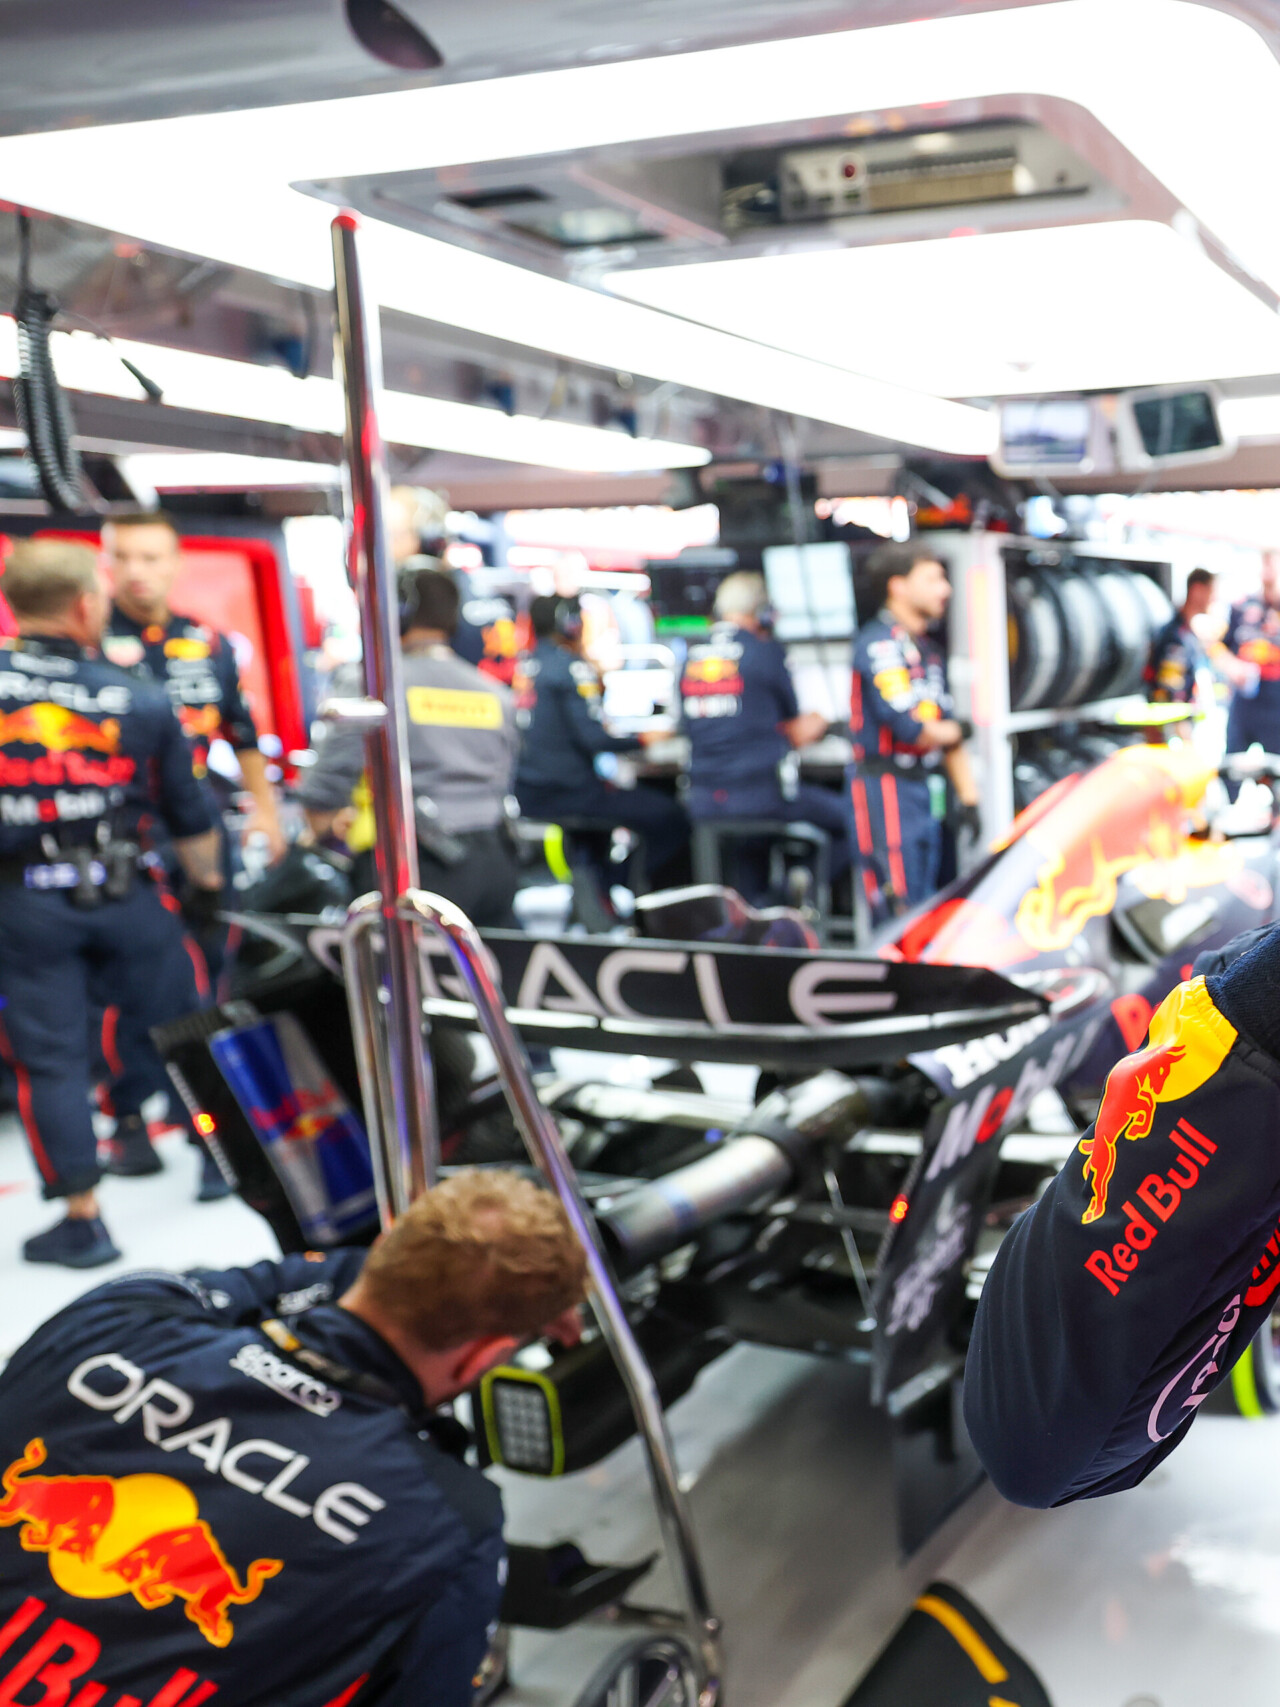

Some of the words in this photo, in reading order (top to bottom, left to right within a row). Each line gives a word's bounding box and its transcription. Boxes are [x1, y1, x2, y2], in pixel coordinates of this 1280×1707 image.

[1083, 1200, 1159, 1297] Red
[1135, 1116, 1219, 1223] Bull
[67, 1352, 387, 1545] ORACLE
